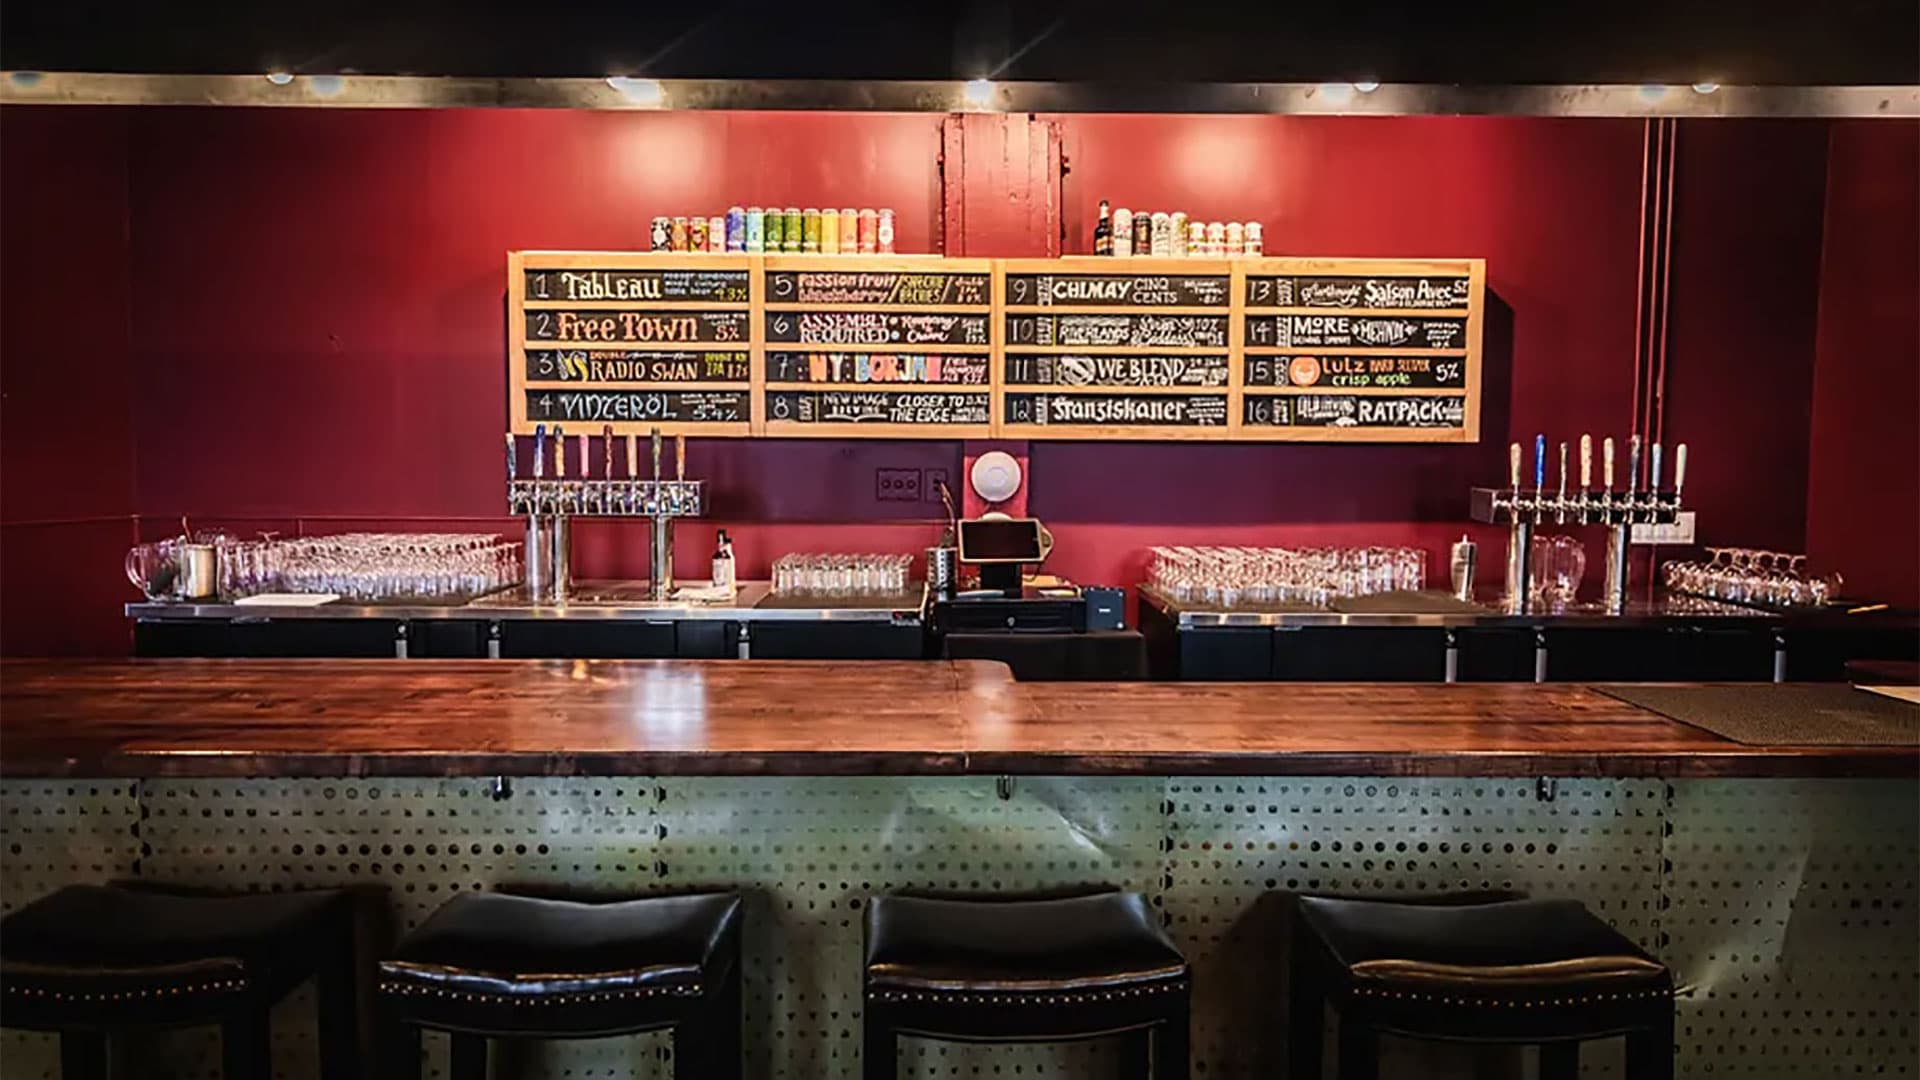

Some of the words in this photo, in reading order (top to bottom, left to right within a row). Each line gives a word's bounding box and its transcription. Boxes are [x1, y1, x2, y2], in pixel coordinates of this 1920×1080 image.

[535, 274, 549, 298] 1
[775, 275, 792, 297] 5
[1013, 278, 1027, 303] 9
[1052, 281, 1132, 300] CHIMAY
[1133, 277, 1170, 291] CINQ
[1250, 280, 1271, 301] 13
[1364, 279, 1415, 302] Saison
[1417, 279, 1452, 300] Avec
[1132, 291, 1178, 304] CENTS
[537, 313, 552, 338] 2
[557, 312, 616, 341] Free
[619, 312, 698, 341] Town
[715, 326, 740, 341] 5%
[774, 315, 790, 335] 6
[800, 313, 889, 329] ASSEMBLY
[800, 328, 889, 343] REQUIRED
[1012, 319, 1034, 342] 10
[1251, 322, 1271, 342] 14
[1294, 316, 1350, 335] MORE
[539, 352, 554, 375] 3
[591, 361, 646, 381] RADIO
[651, 361, 699, 381] SWAN
[773, 354, 788, 378] 7
[1015, 359, 1028, 381] 11
[1097, 358, 1128, 378] WE
[1129, 358, 1186, 379] BLEND
[1249, 361, 1269, 383] 15
[1332, 373, 1371, 387] crisp
[1375, 372, 1413, 387] apple
[1436, 362, 1459, 383] 5%
[539, 394, 553, 417] 4
[774, 396, 790, 419] 8
[896, 394, 945, 407] CLOSER
[947, 394, 965, 407] TO
[1011, 400, 1032, 422] 12
[1050, 396, 1186, 422] Franziskaner
[1249, 401, 1269, 422] 16
[889, 407, 916, 422] THE
[916, 407, 951, 423] EDGE
